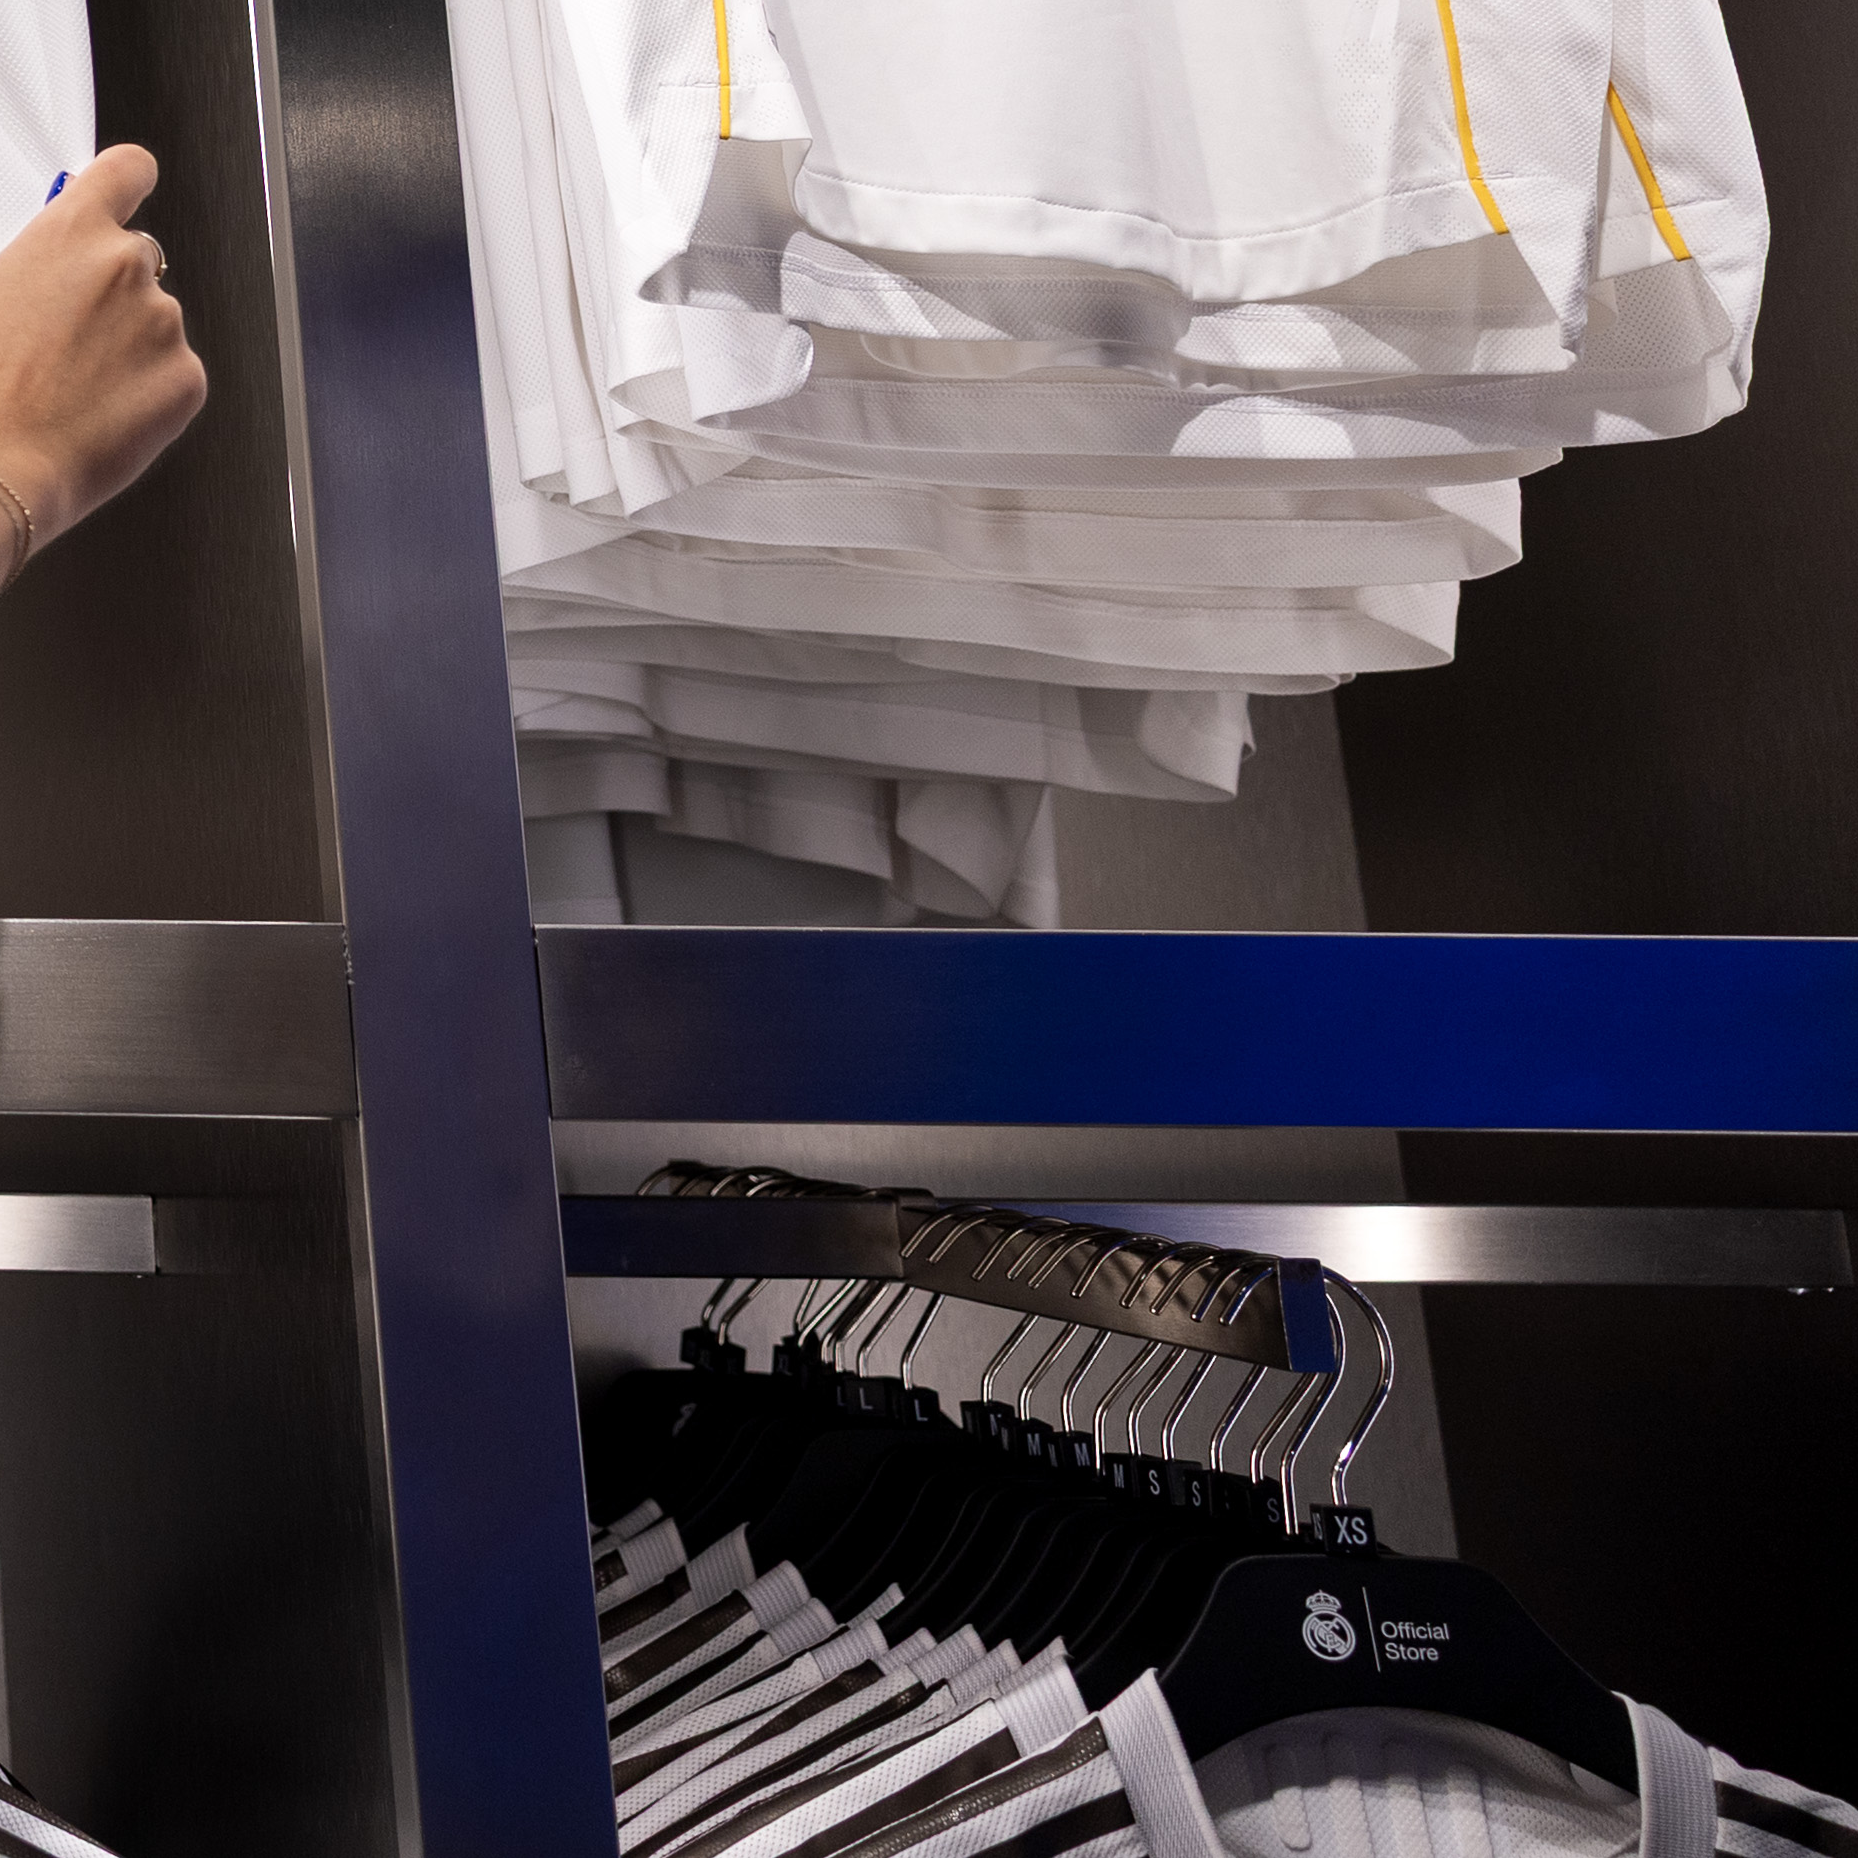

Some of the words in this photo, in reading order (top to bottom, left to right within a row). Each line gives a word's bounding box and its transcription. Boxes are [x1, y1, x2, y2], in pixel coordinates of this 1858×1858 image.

[858, 1387, 874, 1411] L
[913, 1398, 930, 1423] L
[1026, 1432, 1043, 1457] M
[1073, 1441, 1091, 1467] M
[1148, 1468, 1161, 1496] S
[1191, 1479, 1202, 1508] S
[1266, 1497, 1281, 1524] S
[1333, 1514, 1369, 1545] XS
[1380, 1620, 1451, 1641] Official
[1384, 1642, 1439, 1662] Store
